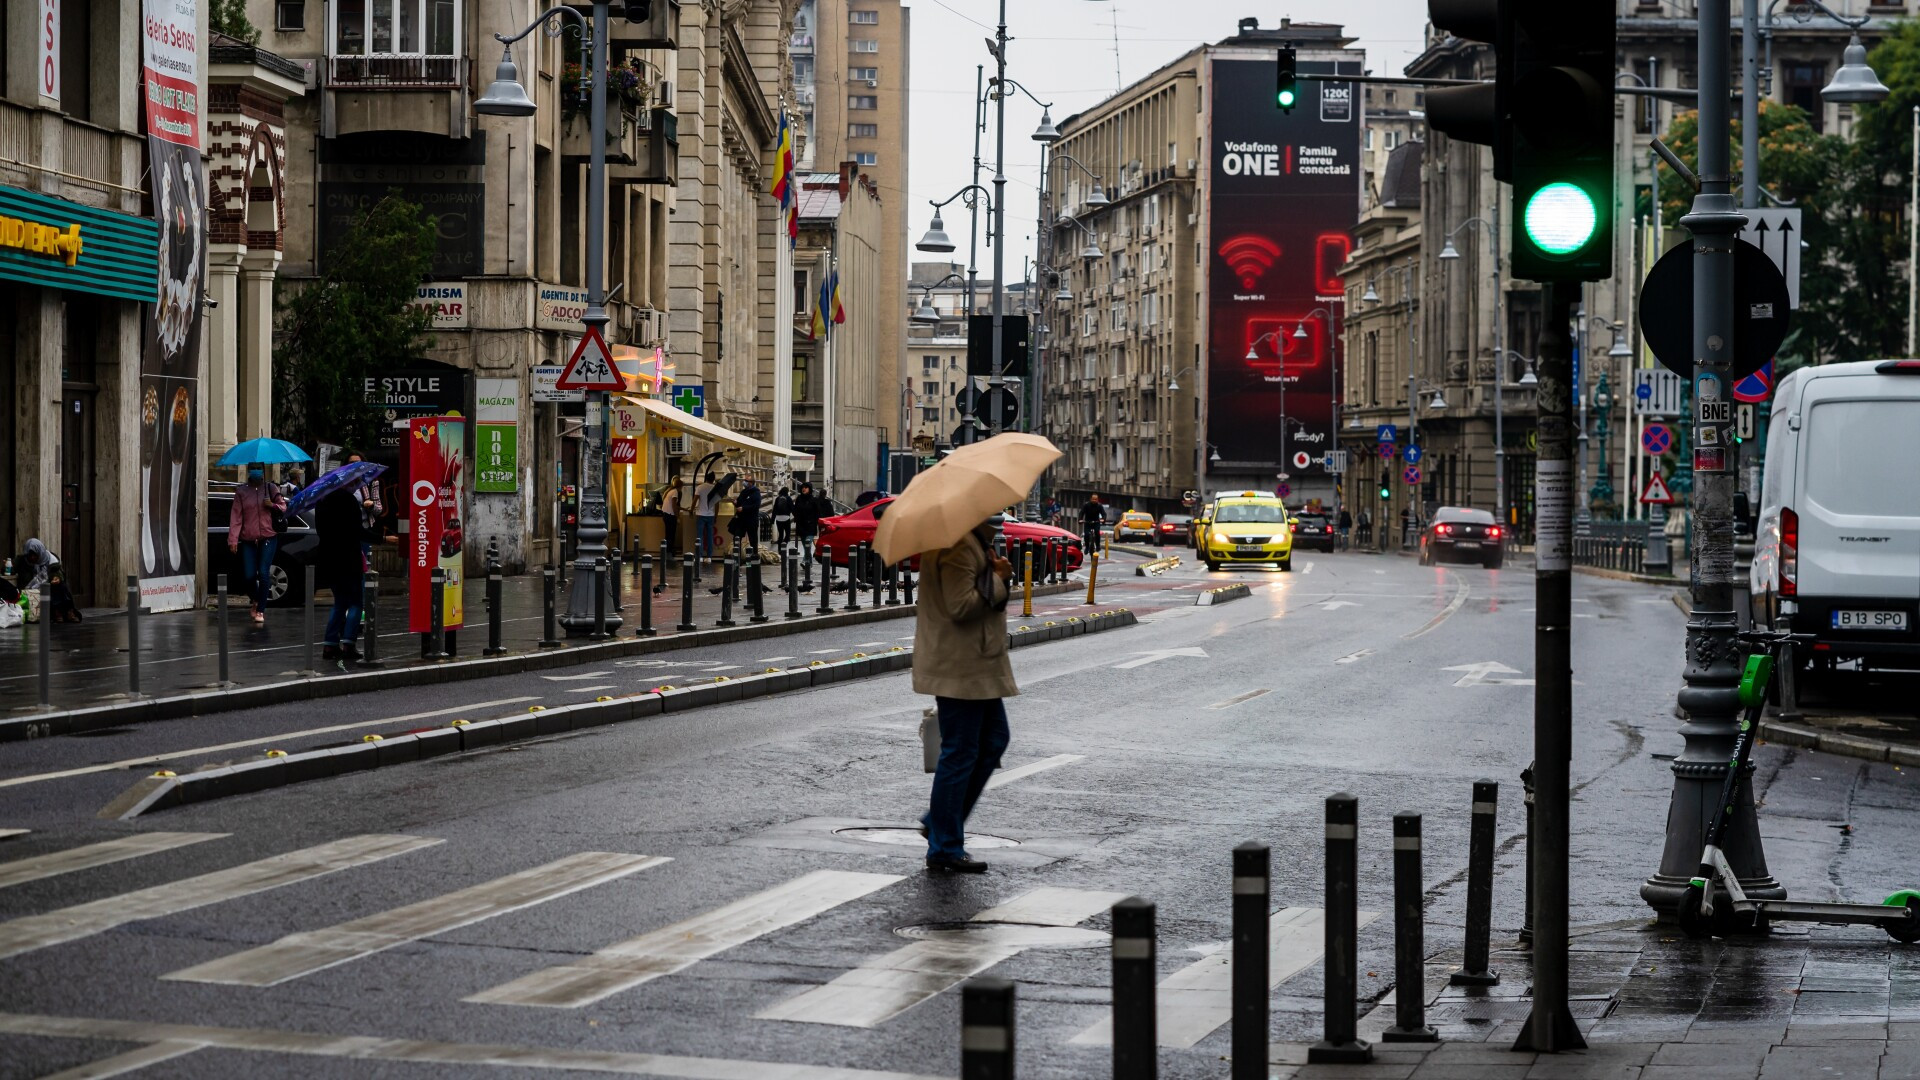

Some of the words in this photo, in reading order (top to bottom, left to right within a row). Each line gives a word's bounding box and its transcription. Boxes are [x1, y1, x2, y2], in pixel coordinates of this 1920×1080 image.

[169, 22, 195, 53] Senso
[45, 0, 54, 94] SO
[1323, 89, 1349, 98] 120€
[1224, 141, 1278, 152] Vodafone
[1299, 146, 1337, 156] Familia
[1222, 153, 1280, 176] ONE
[1299, 157, 1332, 165] mereu
[1299, 164, 1350, 174] conectată
[25, 222, 60, 256] BAR
[418, 288, 462, 298] URISM
[571, 293, 579, 302] DE
[401, 304, 462, 315] OMAR
[551, 306, 585, 319] ADCO
[381, 377, 440, 392] STYLE
[479, 398, 514, 406] MAGAZIN
[617, 410, 631, 421] To
[1702, 403, 1728, 420] BNE
[621, 420, 636, 431] go
[491, 431, 502, 466] non
[613, 442, 636, 462] illy
[418, 509, 430, 568] vodafone
[1842, 612, 1851, 624] B
[1856, 612, 1867, 624] 13
[1874, 613, 1902, 625] SPO
